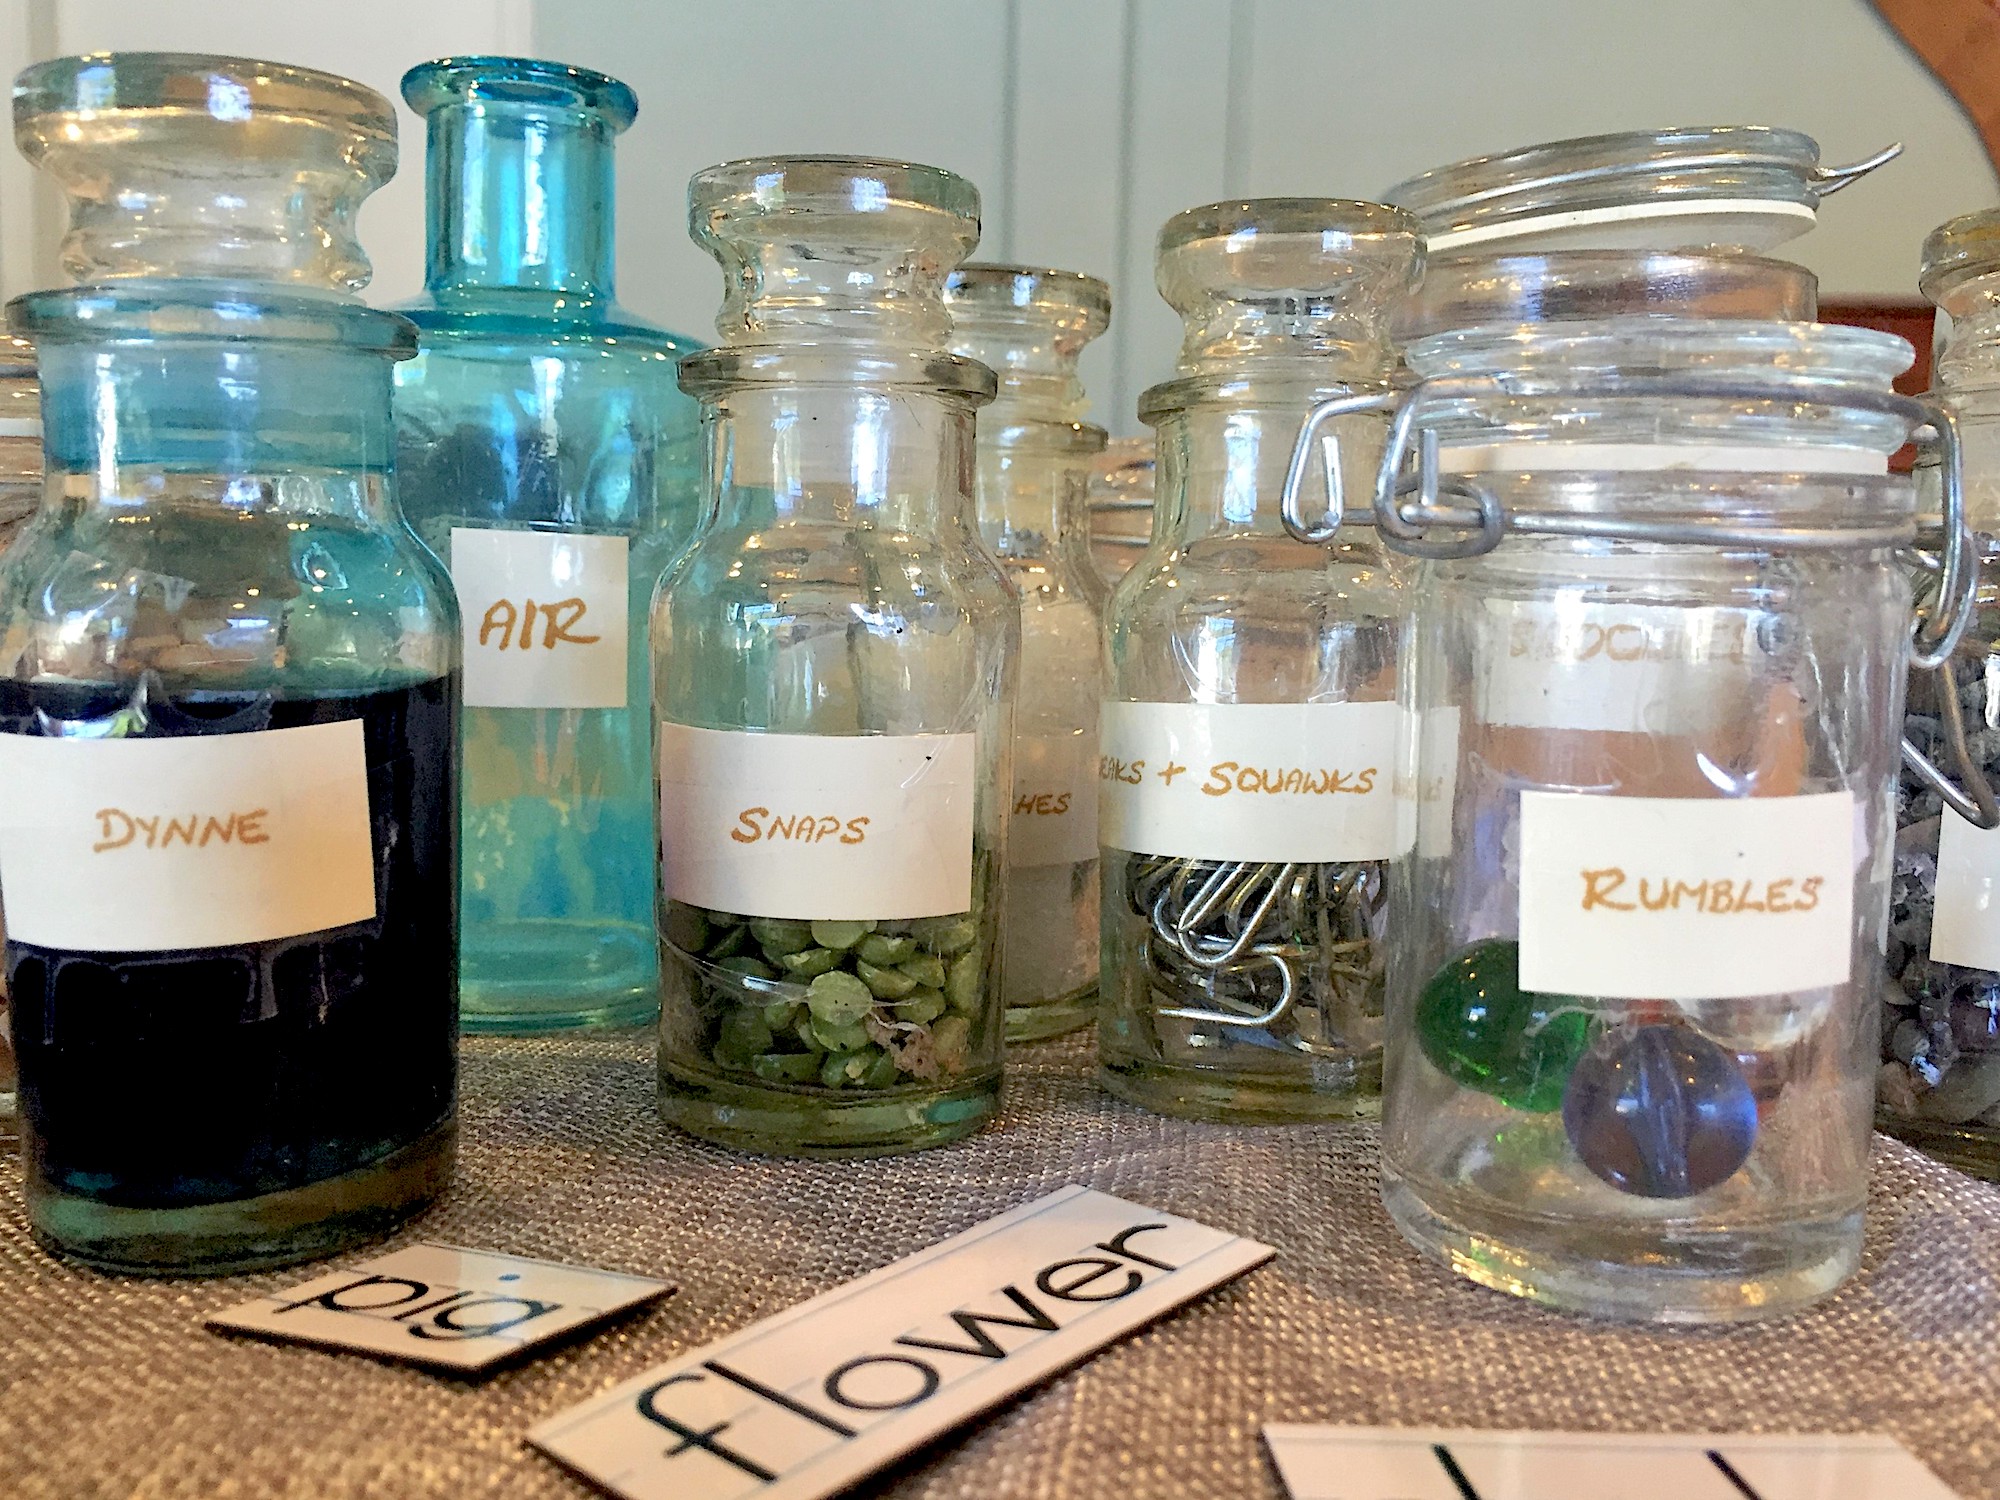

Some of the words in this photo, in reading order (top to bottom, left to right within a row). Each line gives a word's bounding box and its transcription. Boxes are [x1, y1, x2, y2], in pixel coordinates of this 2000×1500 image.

[479, 597, 600, 651] AIR
[1157, 761, 1187, 786] +
[1201, 762, 1378, 797] SQUAWKS
[93, 808, 270, 852] DYNNE
[731, 807, 871, 845] SNAPS
[1582, 867, 1824, 914] RUMBLES
[272, 1274, 563, 1341] pig
[637, 1223, 1177, 1483] flower
